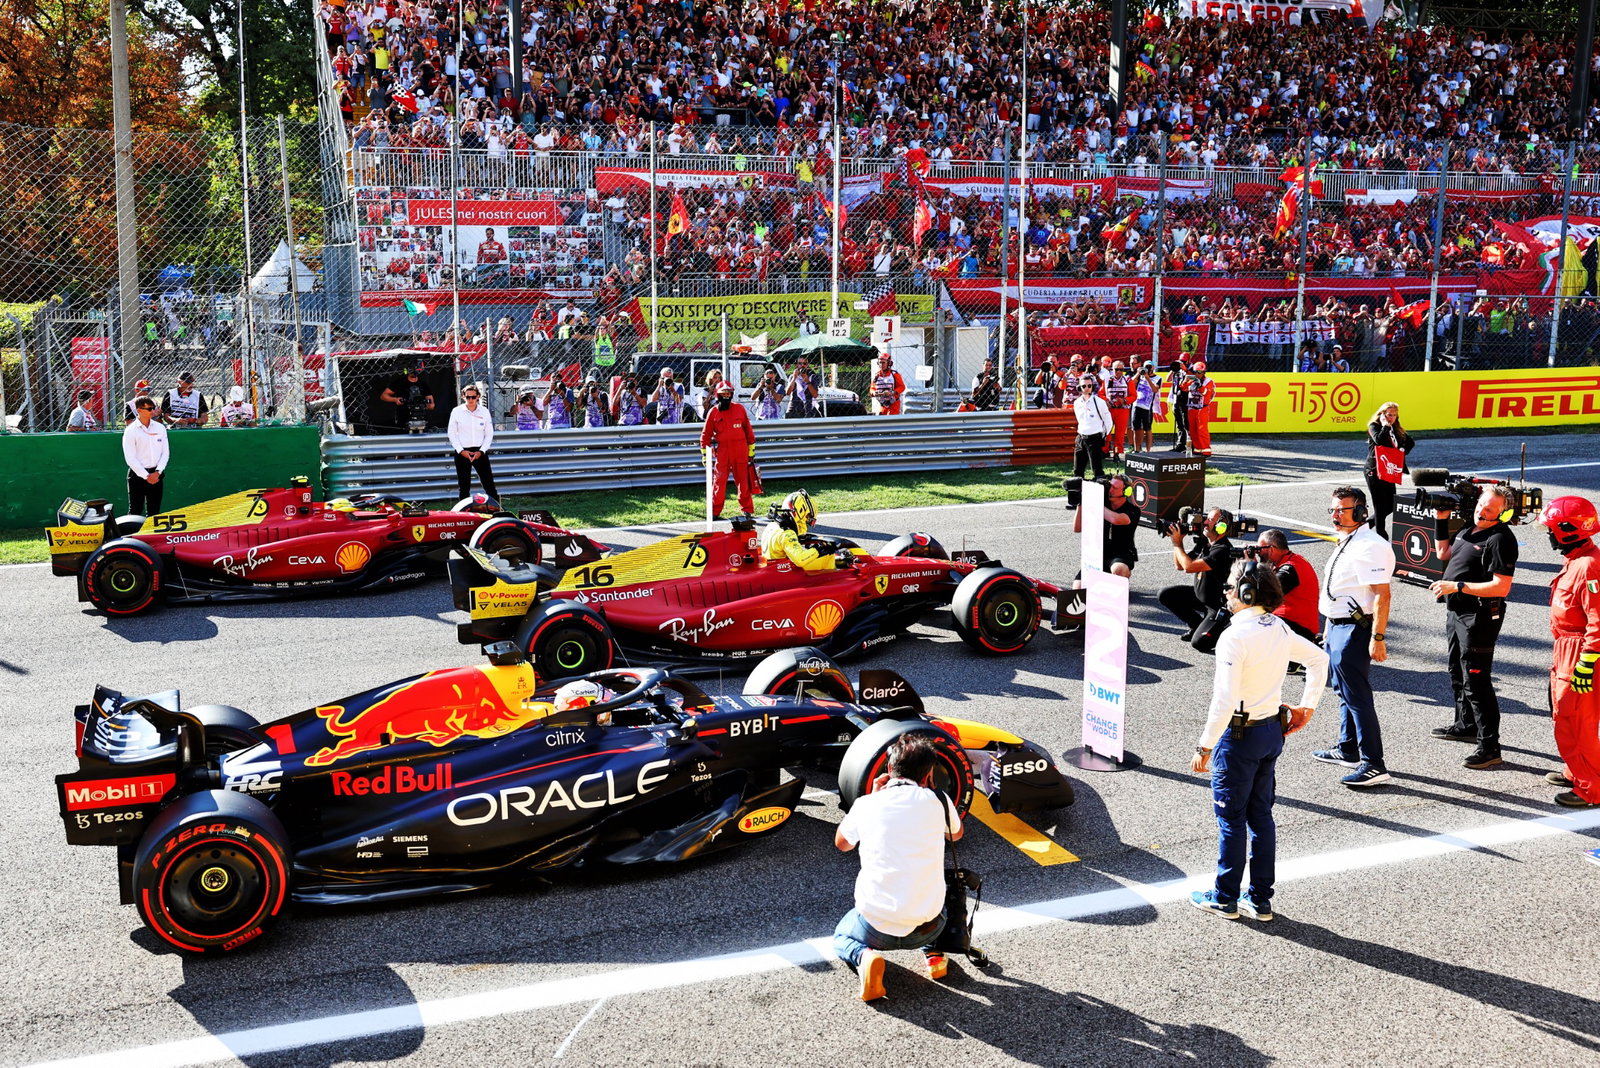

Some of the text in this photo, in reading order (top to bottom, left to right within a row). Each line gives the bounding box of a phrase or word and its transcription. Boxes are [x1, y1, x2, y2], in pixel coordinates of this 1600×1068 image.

[415, 206, 548, 222] JULES nei nostri cuori
[1022, 288, 1057, 297] CUDERIA
[687, 304, 700, 318] SI
[742, 299, 827, 316] DESCRIVERE
[833, 320, 846, 328] MP
[831, 329, 847, 337] 12.2
[1091, 338, 1134, 347] FERRARI
[1330, 415, 1357, 424] YEARS
[1126, 459, 1156, 473] FERRARI
[1162, 463, 1202, 473] FERRARI
[522, 513, 542, 522] aws
[1396, 502, 1438, 519] FERRAR
[153, 514, 188, 534] 55
[63, 530, 99, 538] V-Power
[67, 538, 99, 546] VELAS
[166, 530, 221, 545] Santander
[1410, 535, 1423, 557] 1
[212, 546, 274, 577] Ray-Ban
[394, 571, 426, 582] Snapdragon
[573, 564, 615, 589] 16
[890, 569, 941, 580] RICHARD MILLE
[489, 591, 530, 600] V-Power
[590, 586, 655, 604] Santander
[492, 600, 528, 609] VELAS
[658, 608, 736, 644] Ray-Ban
[866, 633, 896, 648] Snapdragon
[798, 660, 830, 670] Hard Rock
[862, 686, 899, 700] Claro
[1097, 687, 1120, 705] BWT
[729, 713, 780, 737] BYBIT
[1085, 712, 1118, 732] CHANGE
[264, 723, 297, 755] 1
[545, 727, 586, 748] citrix
[837, 734, 851, 743] FIA
[1092, 724, 1118, 740] WORLD
[1002, 758, 1048, 777] ESSO
[223, 770, 284, 793] HRC
[331, 762, 452, 796] Red Bull
[691, 773, 712, 783] Tezos
[68, 783, 137, 804] Mobil
[446, 757, 671, 827] ORACLE
[93, 809, 144, 825] Tezos
[752, 811, 786, 828] RAUCH
[150, 852, 162, 870] P
[164, 823, 227, 853] ZERO
[392, 834, 429, 843] SIEMENS
